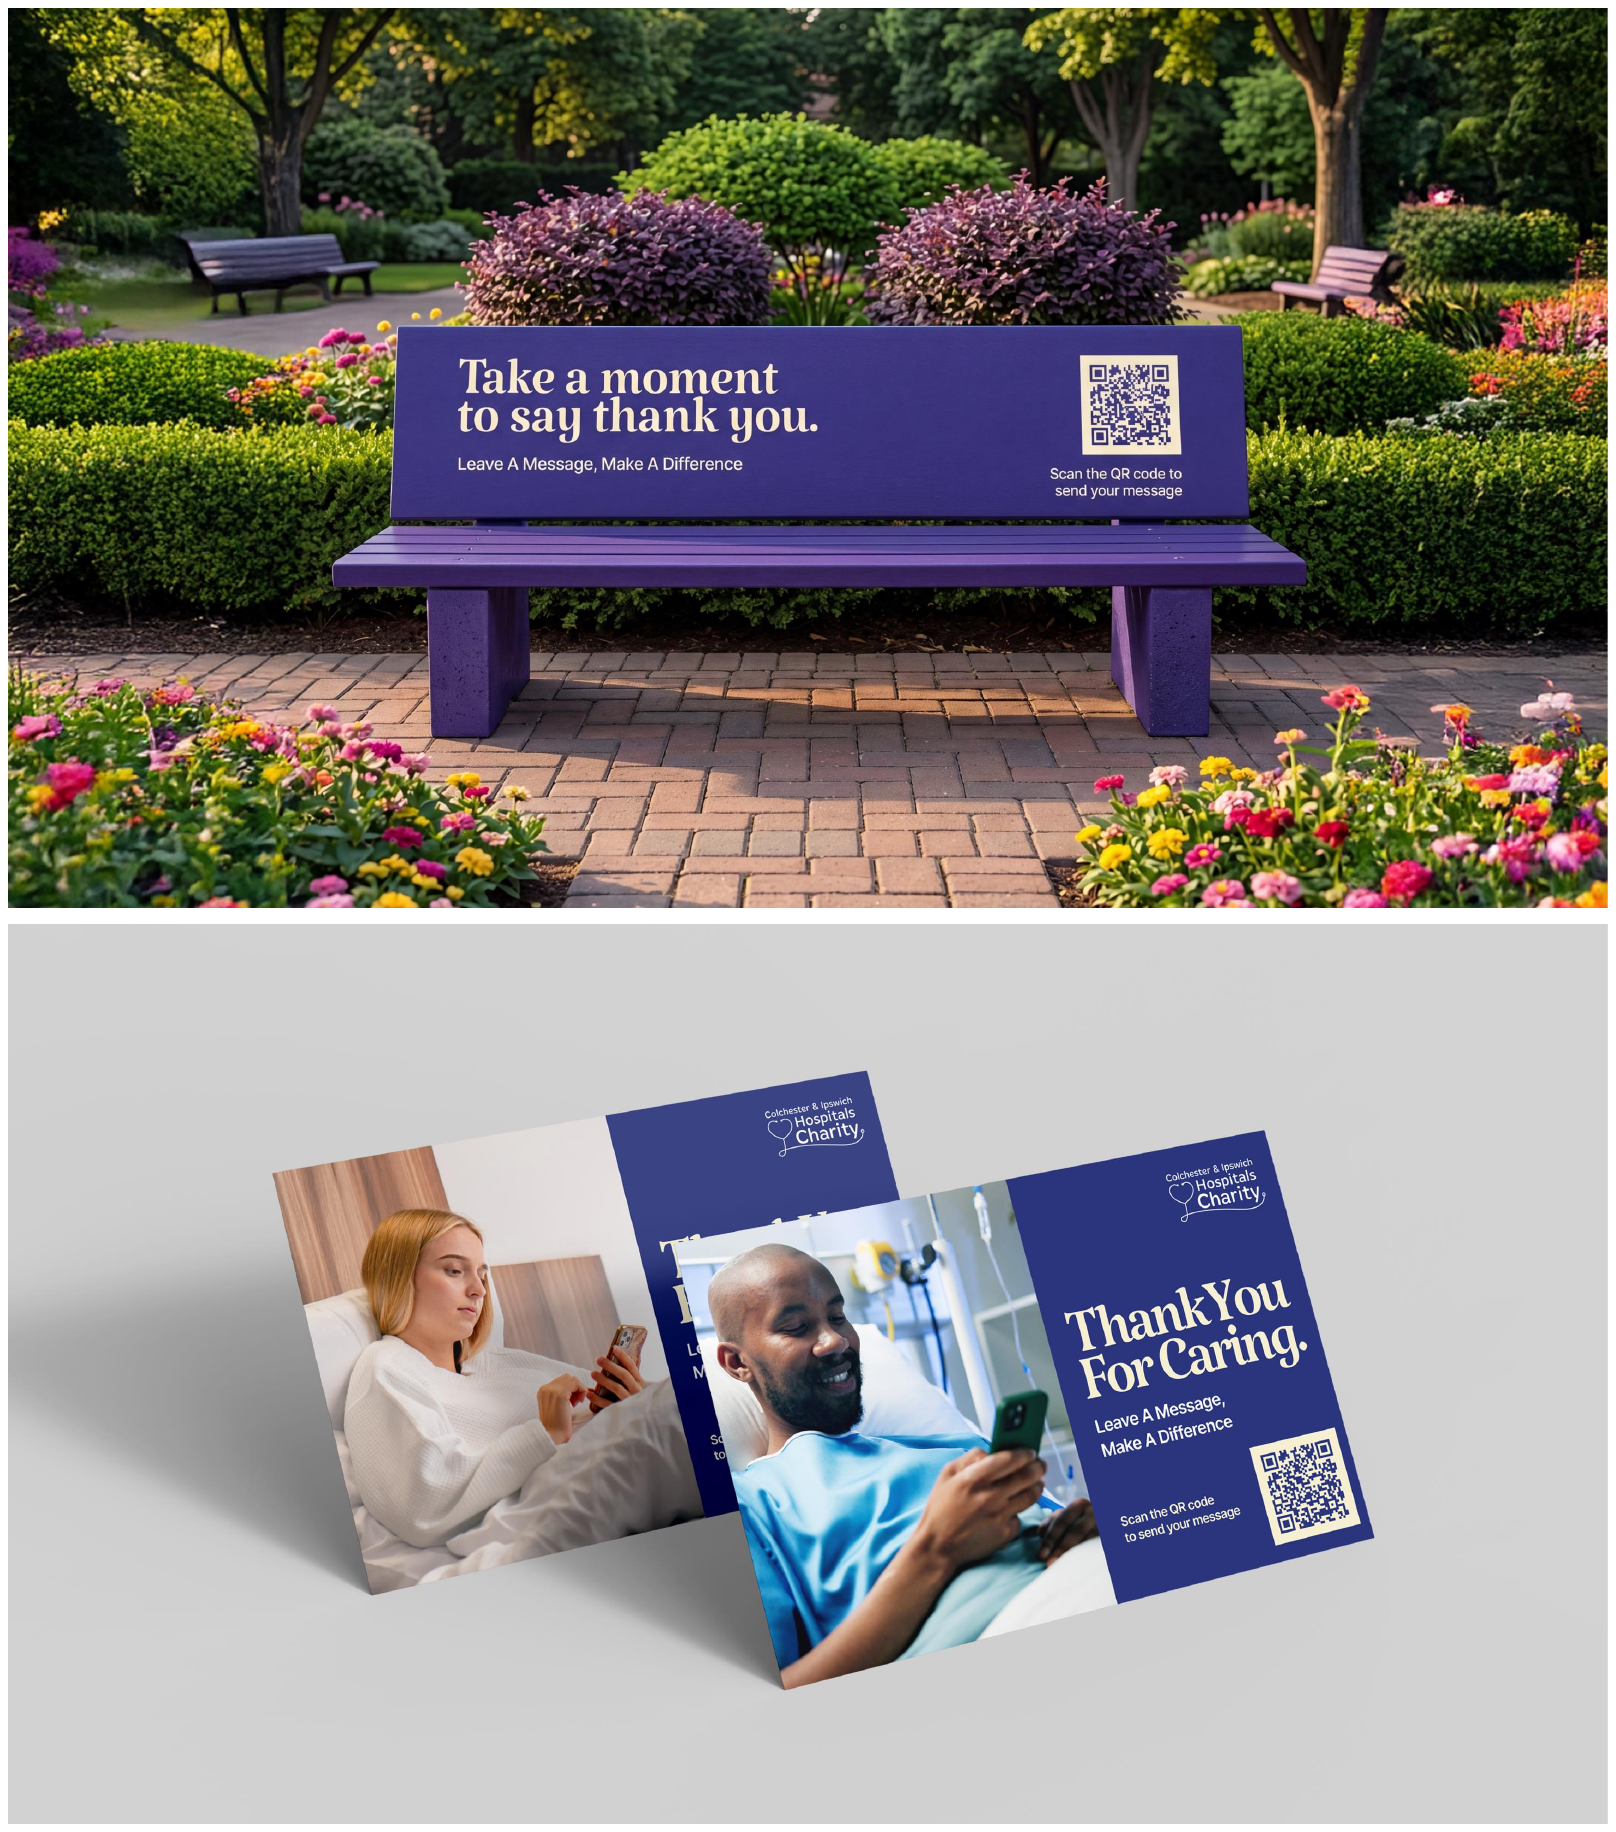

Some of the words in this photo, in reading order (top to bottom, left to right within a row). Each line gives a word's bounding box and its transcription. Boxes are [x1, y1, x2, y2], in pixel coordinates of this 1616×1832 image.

[459, 358, 554, 394] Take
[565, 368, 590, 394] a
[601, 363, 778, 395] moment
[457, 401, 498, 432] to
[510, 407, 580, 443] say
[593, 396, 719, 432] thank
[728, 407, 817, 443] you.
[458, 457, 503, 470] Leave
[507, 457, 518, 470] A
[523, 457, 597, 474] Message,
[602, 457, 643, 470] Make
[647, 457, 658, 470] A
[663, 456, 742, 470] Difference
[1050, 467, 1082, 479] Scan
[1086, 467, 1107, 479] the
[1110, 467, 1130, 480] QR
[1133, 467, 1165, 479] code
[1168, 468, 1182, 479] to
[1055, 484, 1087, 496] send
[1090, 487, 1119, 499] your
[1123, 487, 1182, 499] message
[765, 1105, 809, 1119] Colchester
[812, 1102, 819, 1111] &
[820, 1097, 853, 1110] Ipswich
[794, 1108, 856, 1127] Hospitals
[796, 1122, 859, 1144] Charity
[1165, 1167, 1211, 1182] Colchester
[1213, 1165, 1220, 1173] &
[1221, 1158, 1253, 1173] Ipswich
[1195, 1170, 1257, 1191] Hospitals
[1197, 1186, 1260, 1209] Charity
[1078, 1353, 1153, 1399] For
[1159, 1325, 1307, 1379] Caring.
[1094, 1414, 1139, 1433] Leave
[1142, 1408, 1154, 1422] A
[1154, 1395, 1225, 1419] Message,
[1100, 1438, 1142, 1457] Make
[1145, 1432, 1157, 1447] A
[1157, 1417, 1233, 1444] Difference
[1120, 1513, 1149, 1527] Scan
[1149, 1508, 1168, 1520] the
[1169, 1502, 1187, 1515] QR
[1187, 1496, 1215, 1510] code
[1124, 1532, 1137, 1542] to
[1138, 1523, 1165, 1540] send
[1166, 1518, 1191, 1535] your
[1192, 1507, 1241, 1526] message
